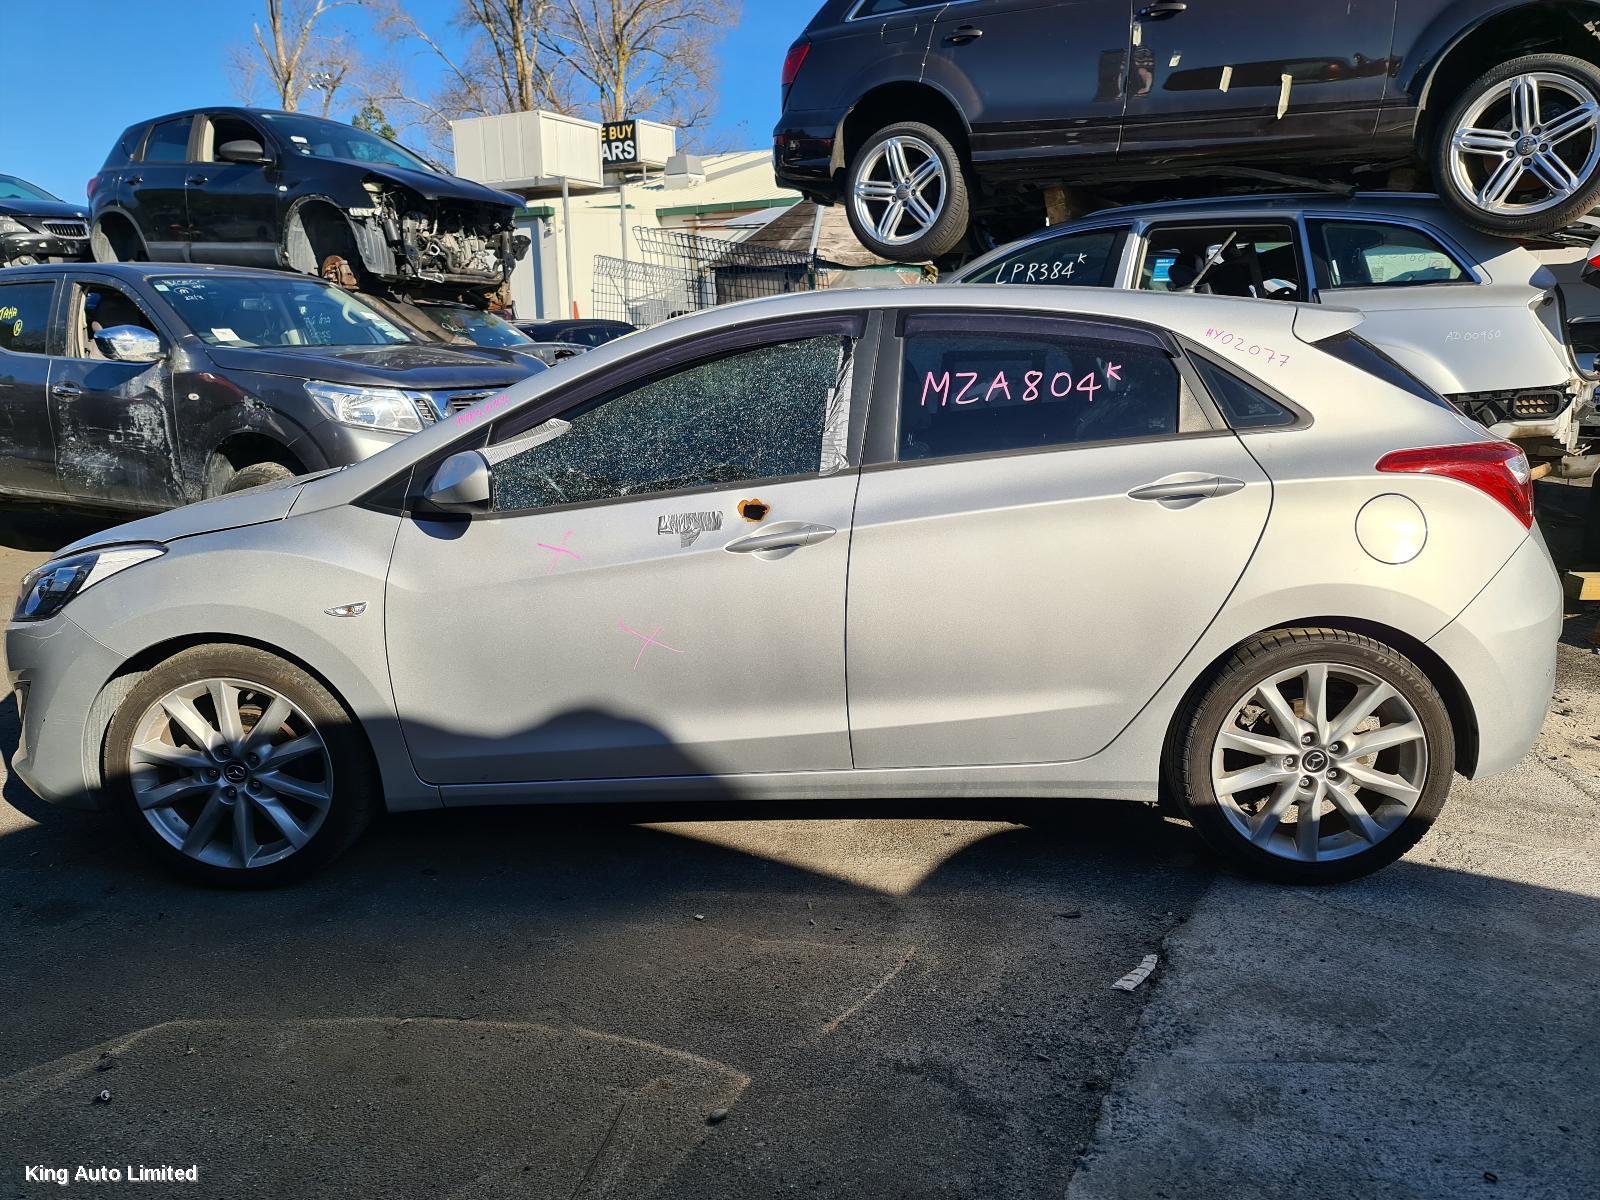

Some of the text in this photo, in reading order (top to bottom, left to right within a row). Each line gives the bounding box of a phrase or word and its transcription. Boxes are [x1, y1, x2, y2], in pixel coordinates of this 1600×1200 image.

[601, 124, 633, 140] E BUY
[601, 140, 636, 160] ARS
[1205, 327, 1290, 367] HY02077
